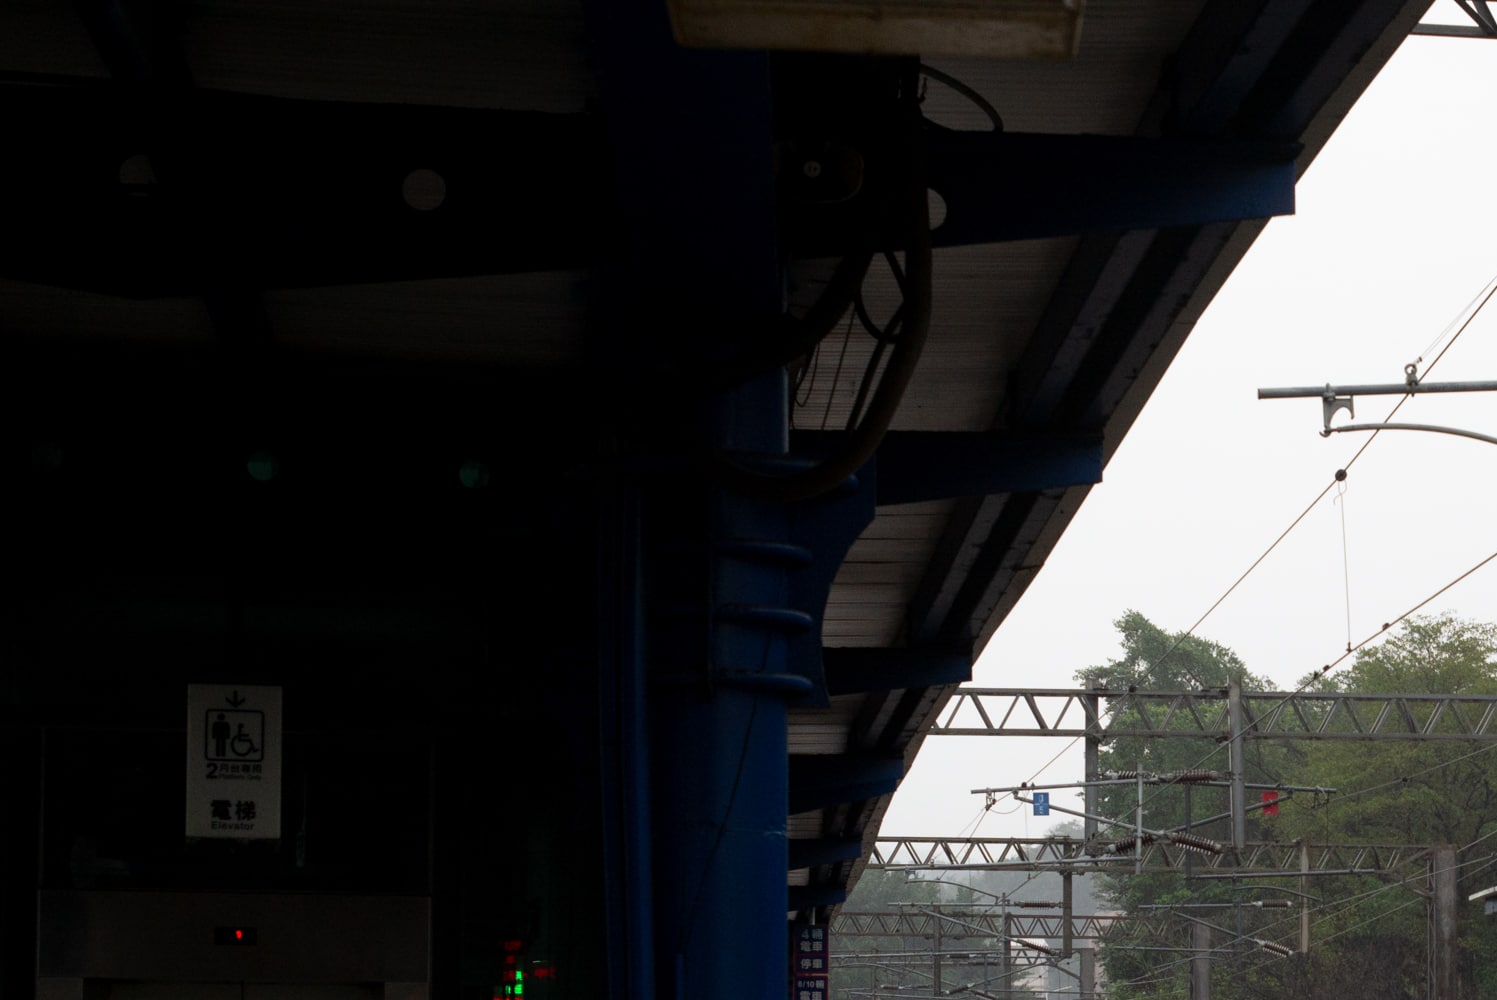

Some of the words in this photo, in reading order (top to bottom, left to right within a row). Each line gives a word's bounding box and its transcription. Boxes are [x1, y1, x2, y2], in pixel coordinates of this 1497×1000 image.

[211, 800, 256, 820] 電梯
[211, 821, 254, 830] Elevator
[800, 941, 822, 952] 電車
[801, 958, 822, 970] 停車
